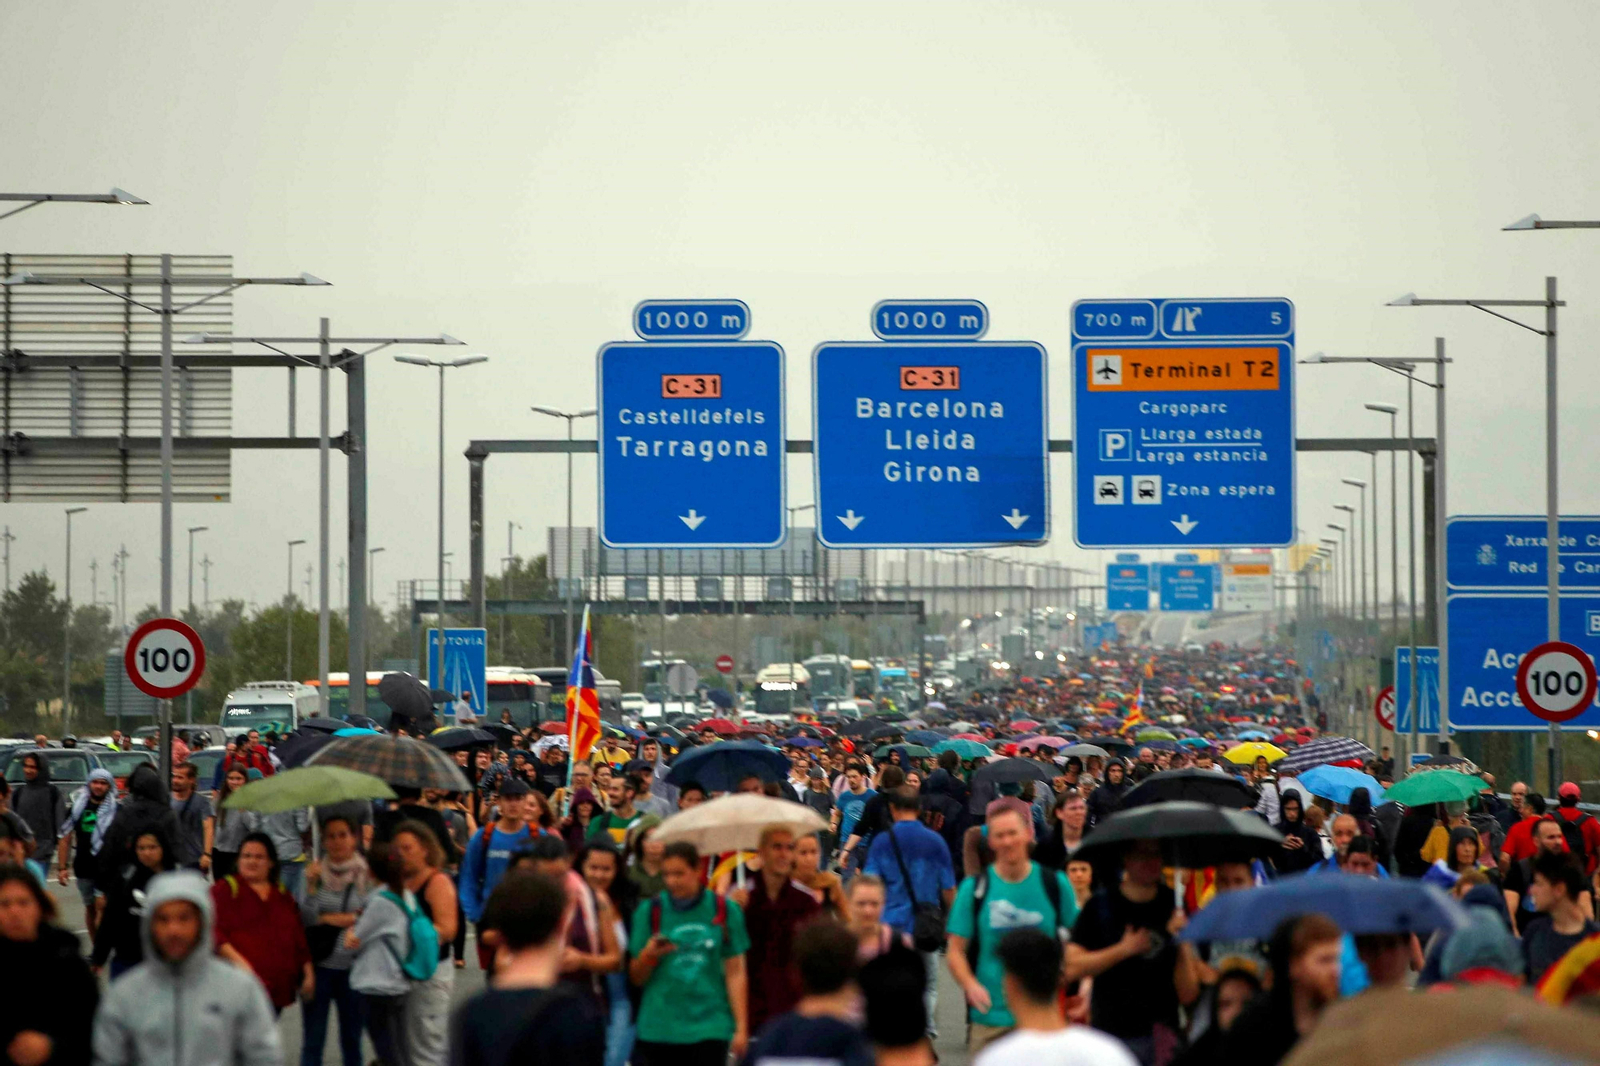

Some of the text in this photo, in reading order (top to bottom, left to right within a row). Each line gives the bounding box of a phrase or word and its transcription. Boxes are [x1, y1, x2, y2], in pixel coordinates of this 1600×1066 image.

[644, 311, 741, 329] 1000 m
[882, 311, 979, 329] 1000 m
[1083, 313, 1147, 327] 700 m
[1271, 311, 1283, 325] 5
[904, 369, 957, 387] C-31
[1130, 360, 1275, 379] Terminal T2
[665, 378, 719, 395] C-31
[618, 407, 766, 425] Castelldefels
[855, 397, 1005, 419] Barcelona
[1138, 400, 1228, 418] Cargoparc
[885, 429, 976, 450] Lleida
[1140, 427, 1263, 443] Llarga estada
[616, 436, 768, 462] Tarragona
[1105, 433, 1126, 458] P
[1135, 448, 1268, 465] Larga estancia
[883, 461, 980, 482] Girona
[1167, 483, 1276, 499] Zona espera
[1505, 534, 1548, 547] Xarxa
[1558, 535, 1577, 547] de
[1508, 561, 1538, 574] Red
[138, 647, 191, 673] 100
[1530, 670, 1583, 696] 100
